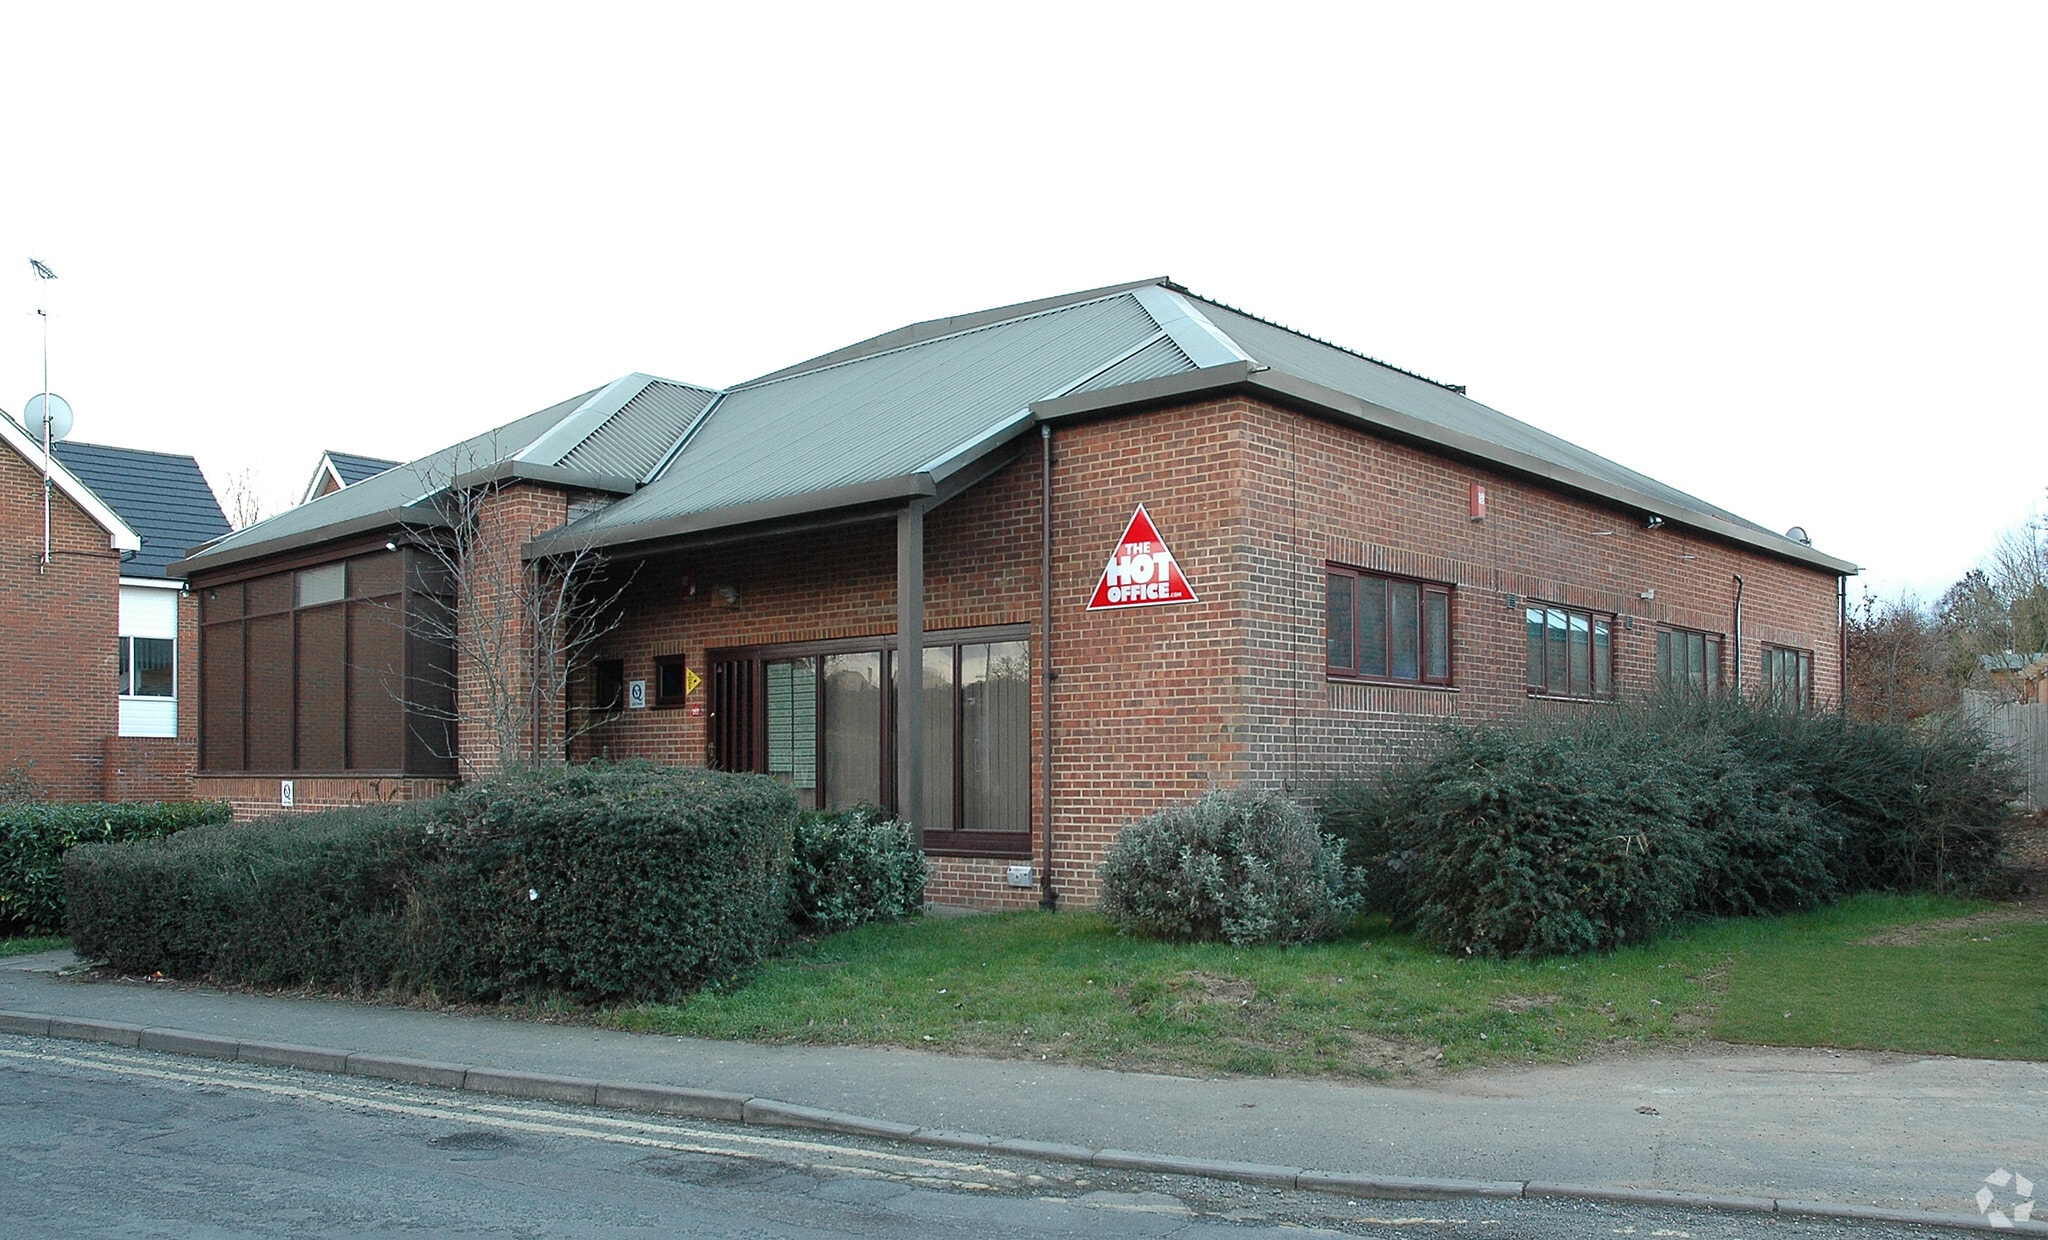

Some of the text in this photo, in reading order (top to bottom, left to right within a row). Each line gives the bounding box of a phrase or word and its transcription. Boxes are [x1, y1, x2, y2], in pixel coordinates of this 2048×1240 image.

[1125, 541, 1150, 554] THE
[1107, 552, 1171, 587] HOT
[1107, 582, 1169, 602] OFFICE
